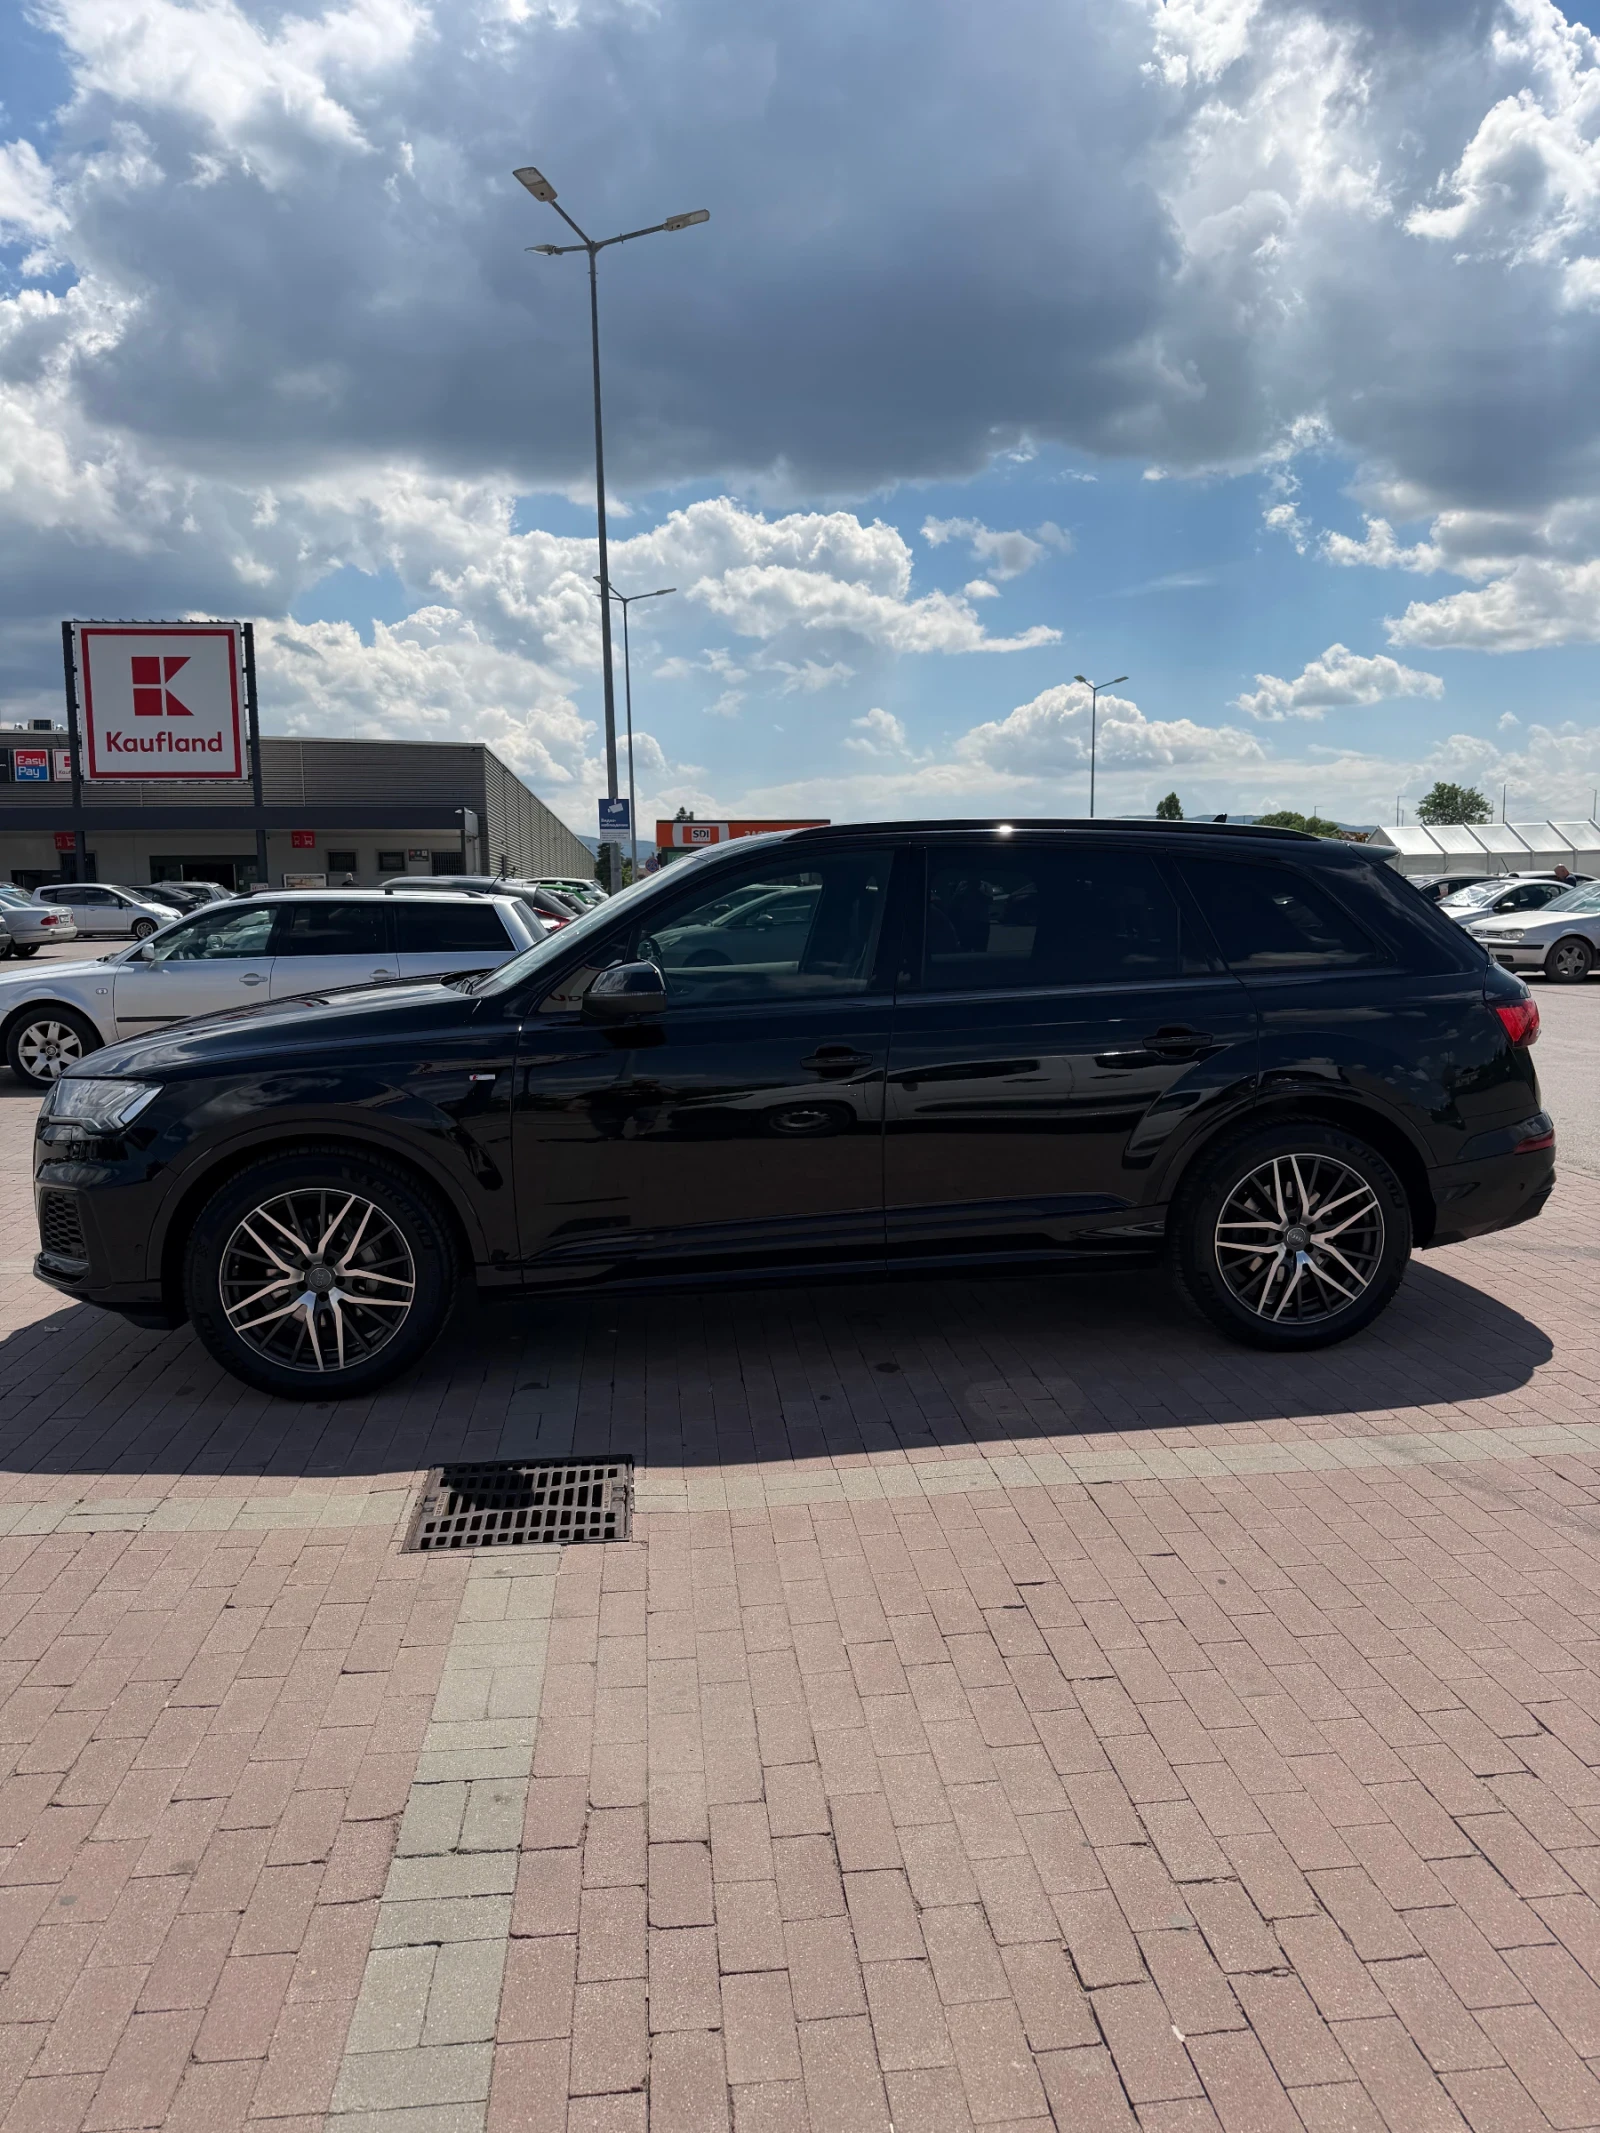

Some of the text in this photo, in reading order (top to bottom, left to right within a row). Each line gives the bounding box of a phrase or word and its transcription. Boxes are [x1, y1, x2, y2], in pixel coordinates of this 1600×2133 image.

[106, 731, 223, 753] Kaufland
[17, 755, 46, 767] Easy
[18, 766, 40, 779] Pay
[692, 829, 710, 838] SDI
[371, 1180, 433, 1245] MICHELIN
